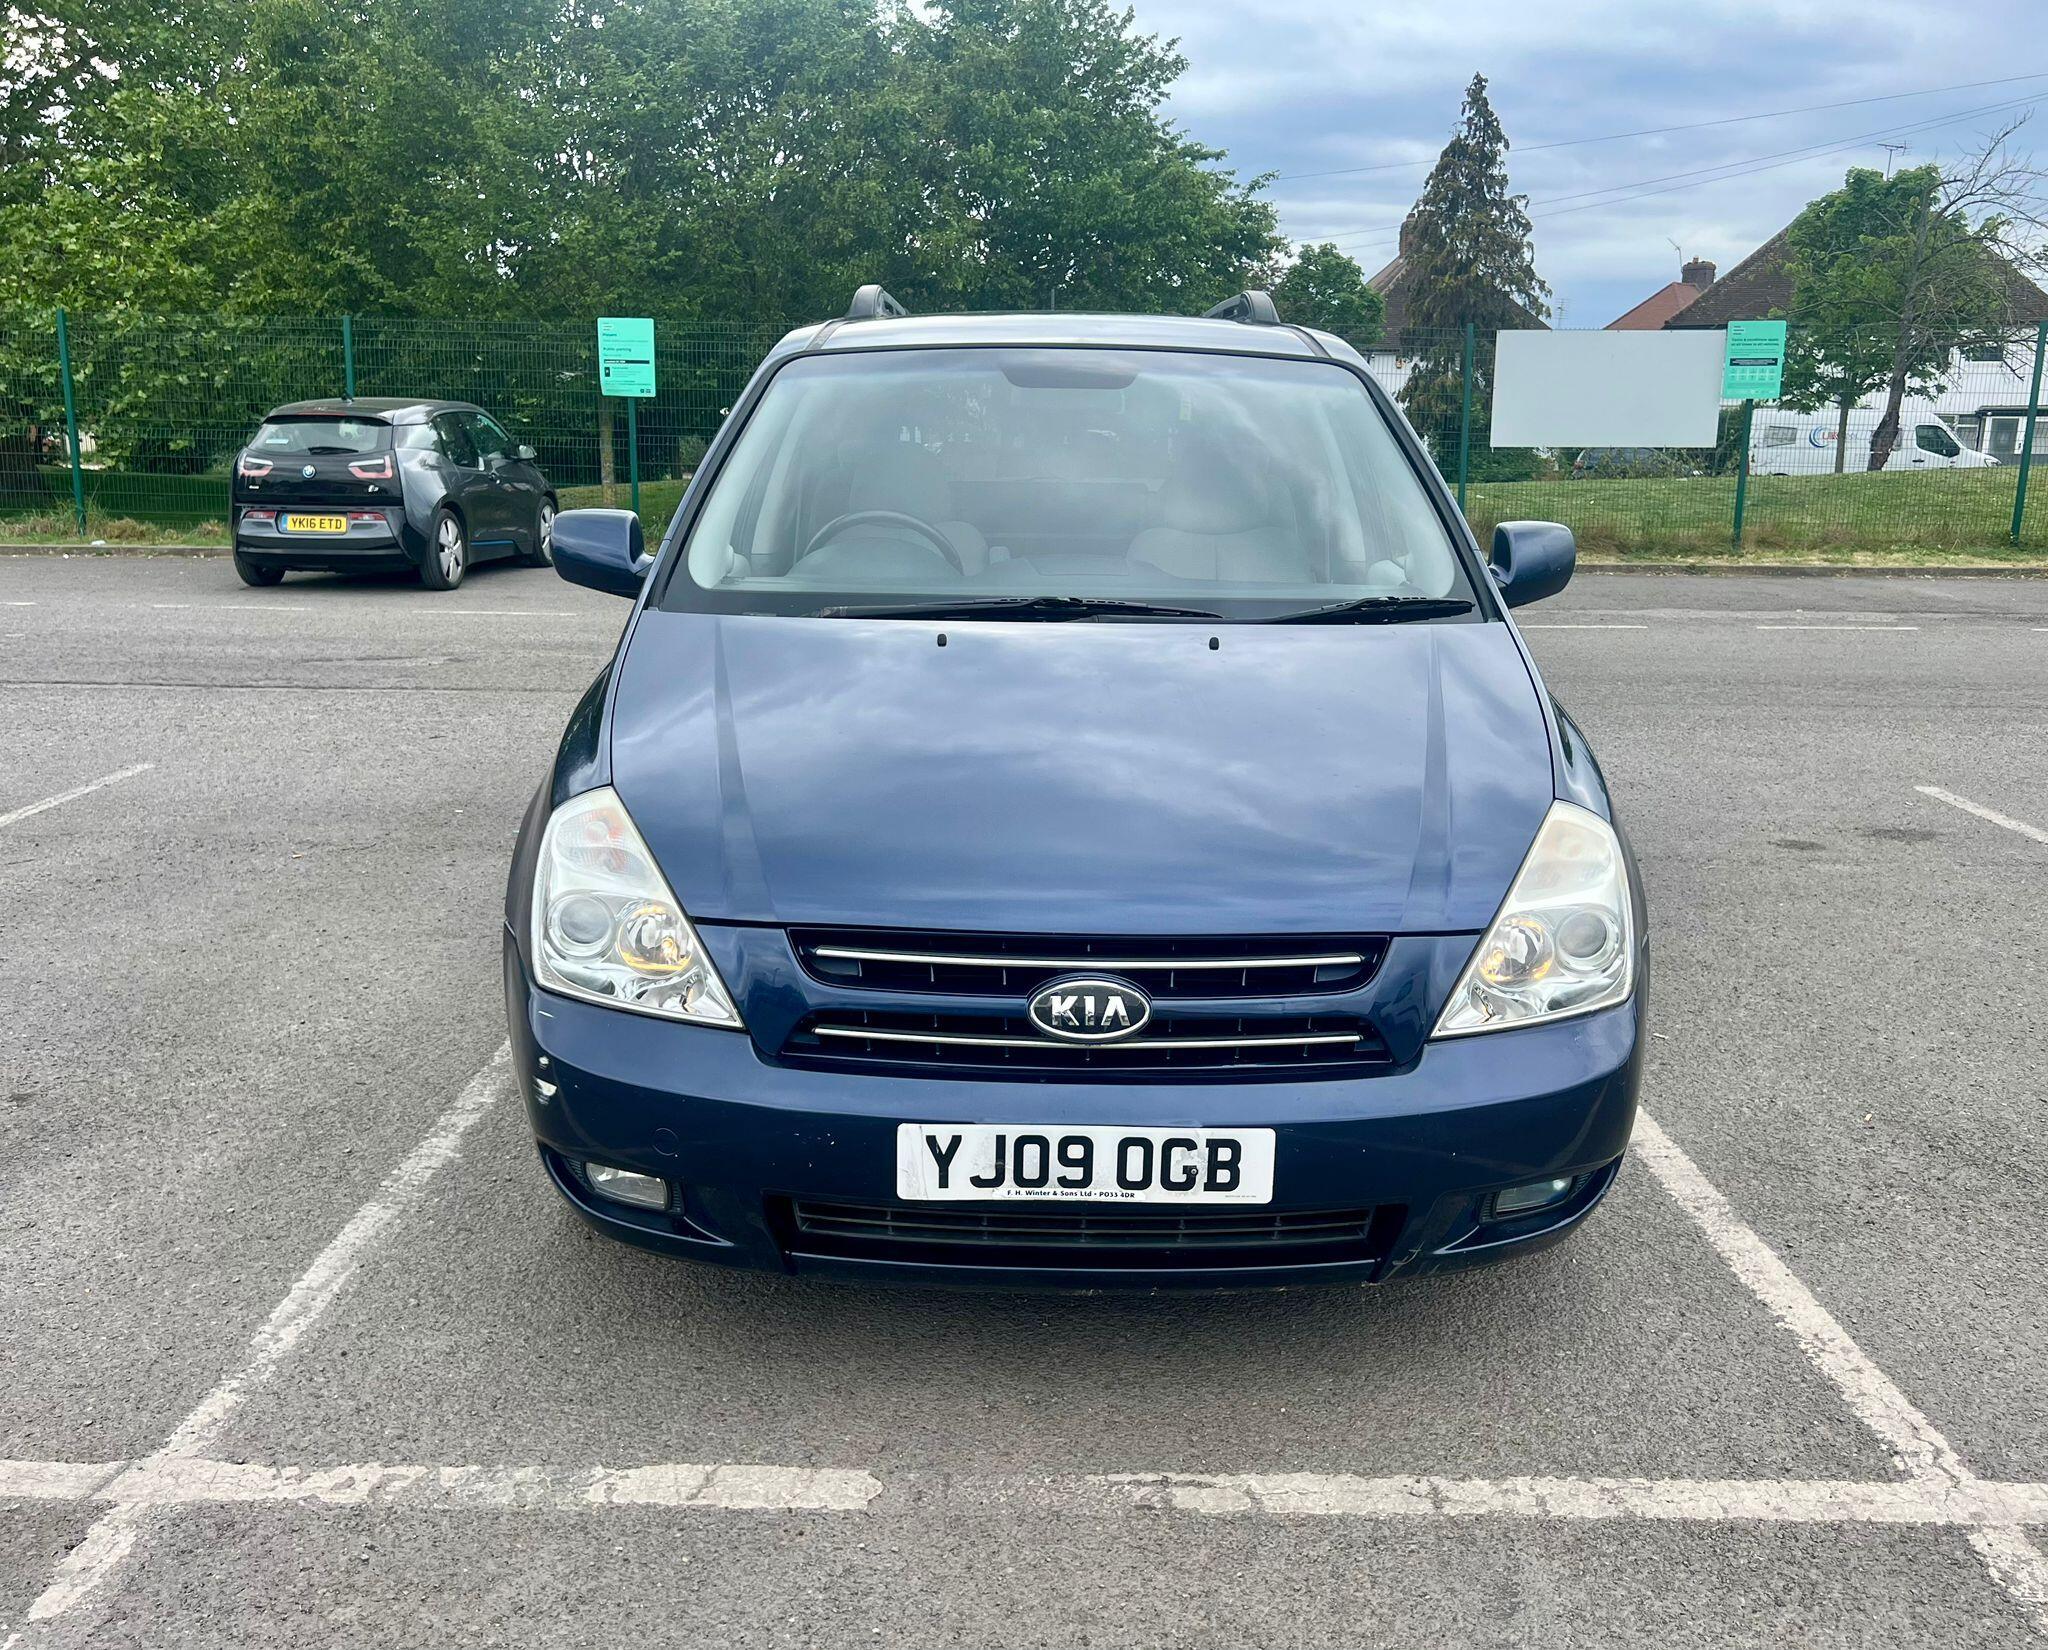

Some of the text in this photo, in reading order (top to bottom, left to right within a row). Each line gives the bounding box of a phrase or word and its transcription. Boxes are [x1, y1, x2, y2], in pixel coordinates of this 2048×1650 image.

[291, 517, 342, 529] YK16 ETD
[1050, 995, 1131, 1026] KIA
[925, 1134, 1242, 1192] YJ09 OGB
